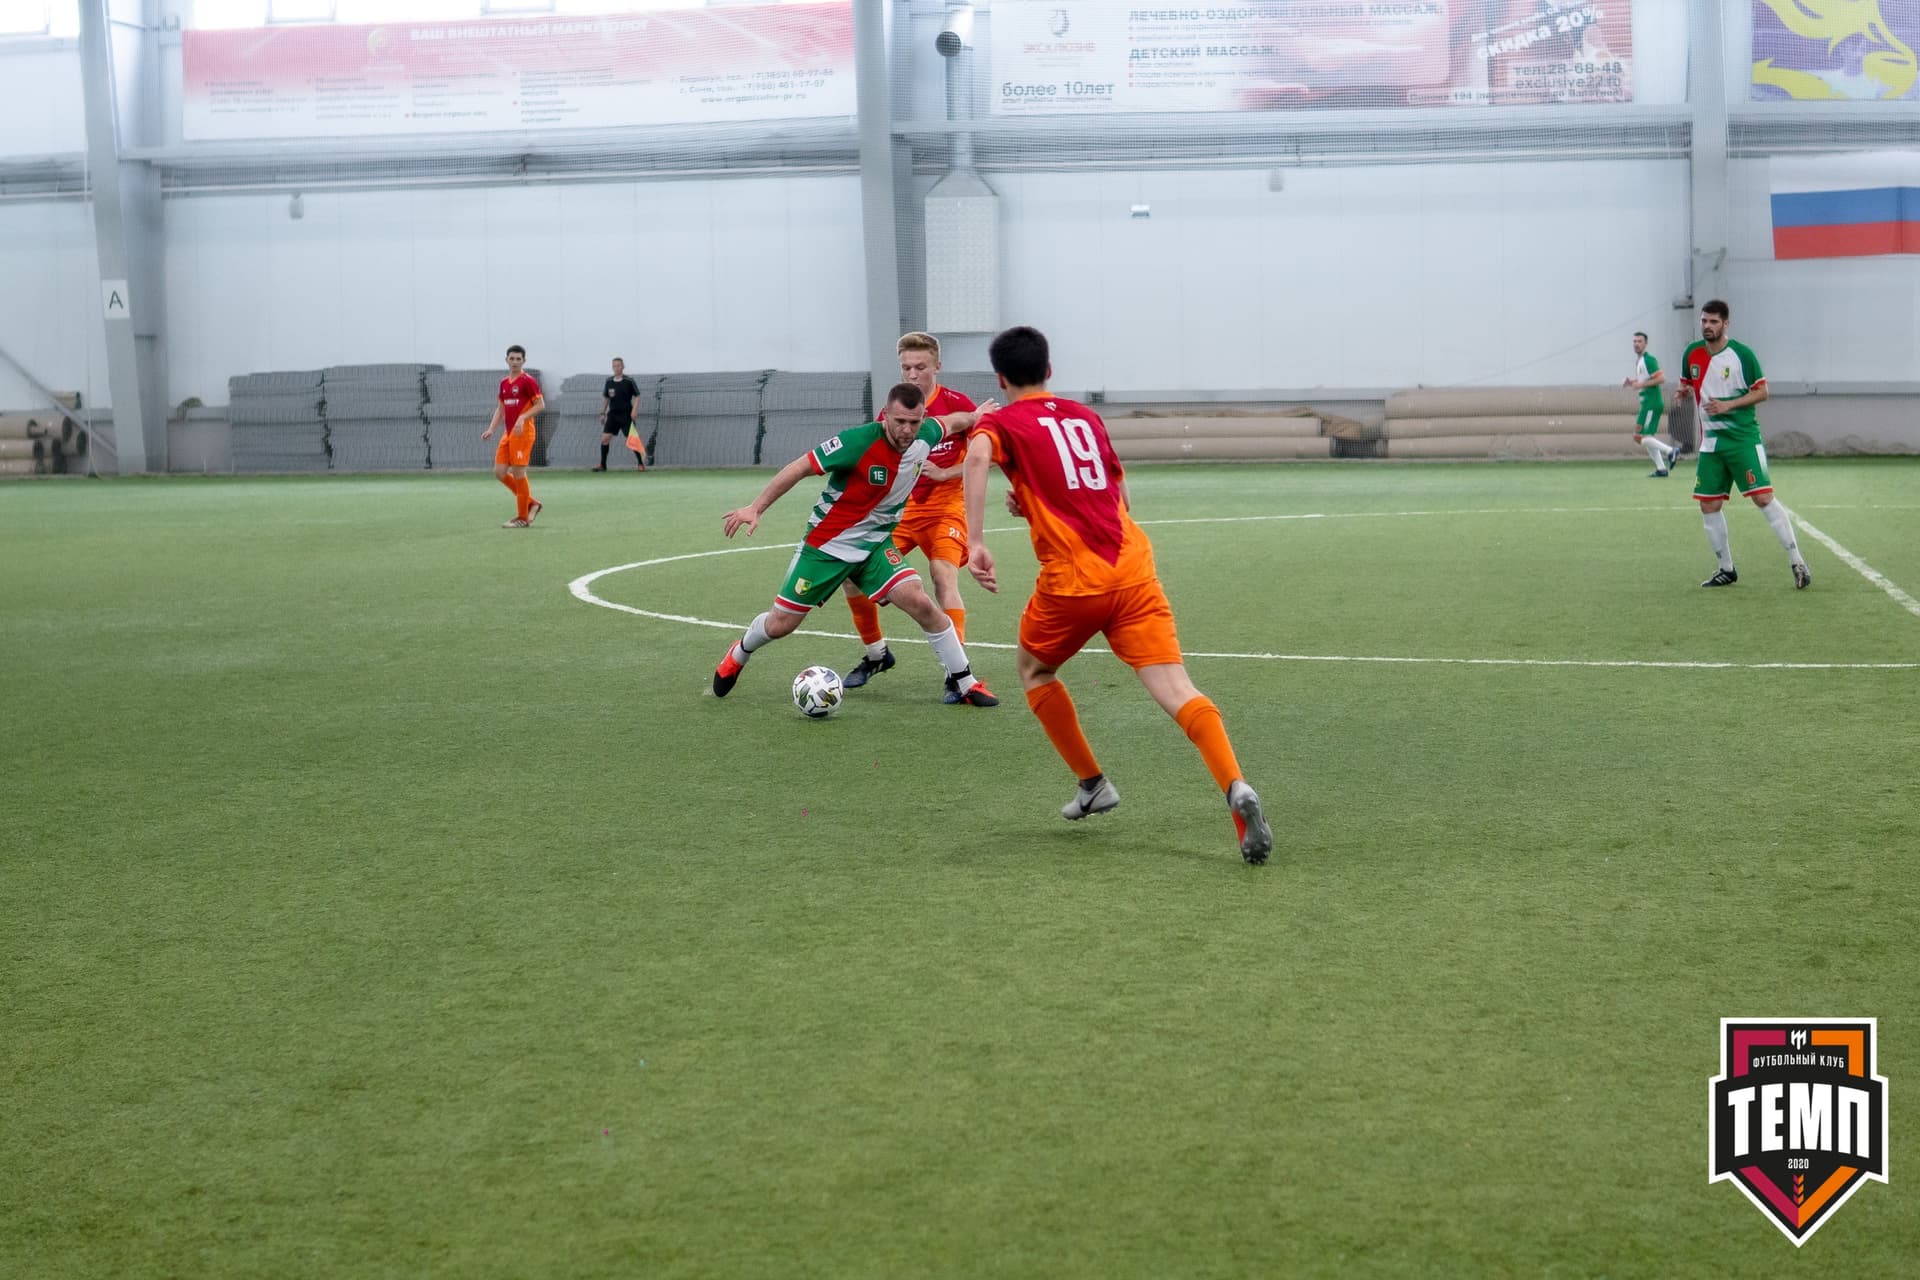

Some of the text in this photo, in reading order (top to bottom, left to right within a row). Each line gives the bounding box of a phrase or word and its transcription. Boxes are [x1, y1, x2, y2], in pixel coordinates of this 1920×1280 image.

[1128, 44, 1201, 60] ДЕТСКИЙ
[1002, 81, 1057, 97] более
[1037, 415, 1107, 490] 19
[884, 547, 903, 566] 5
